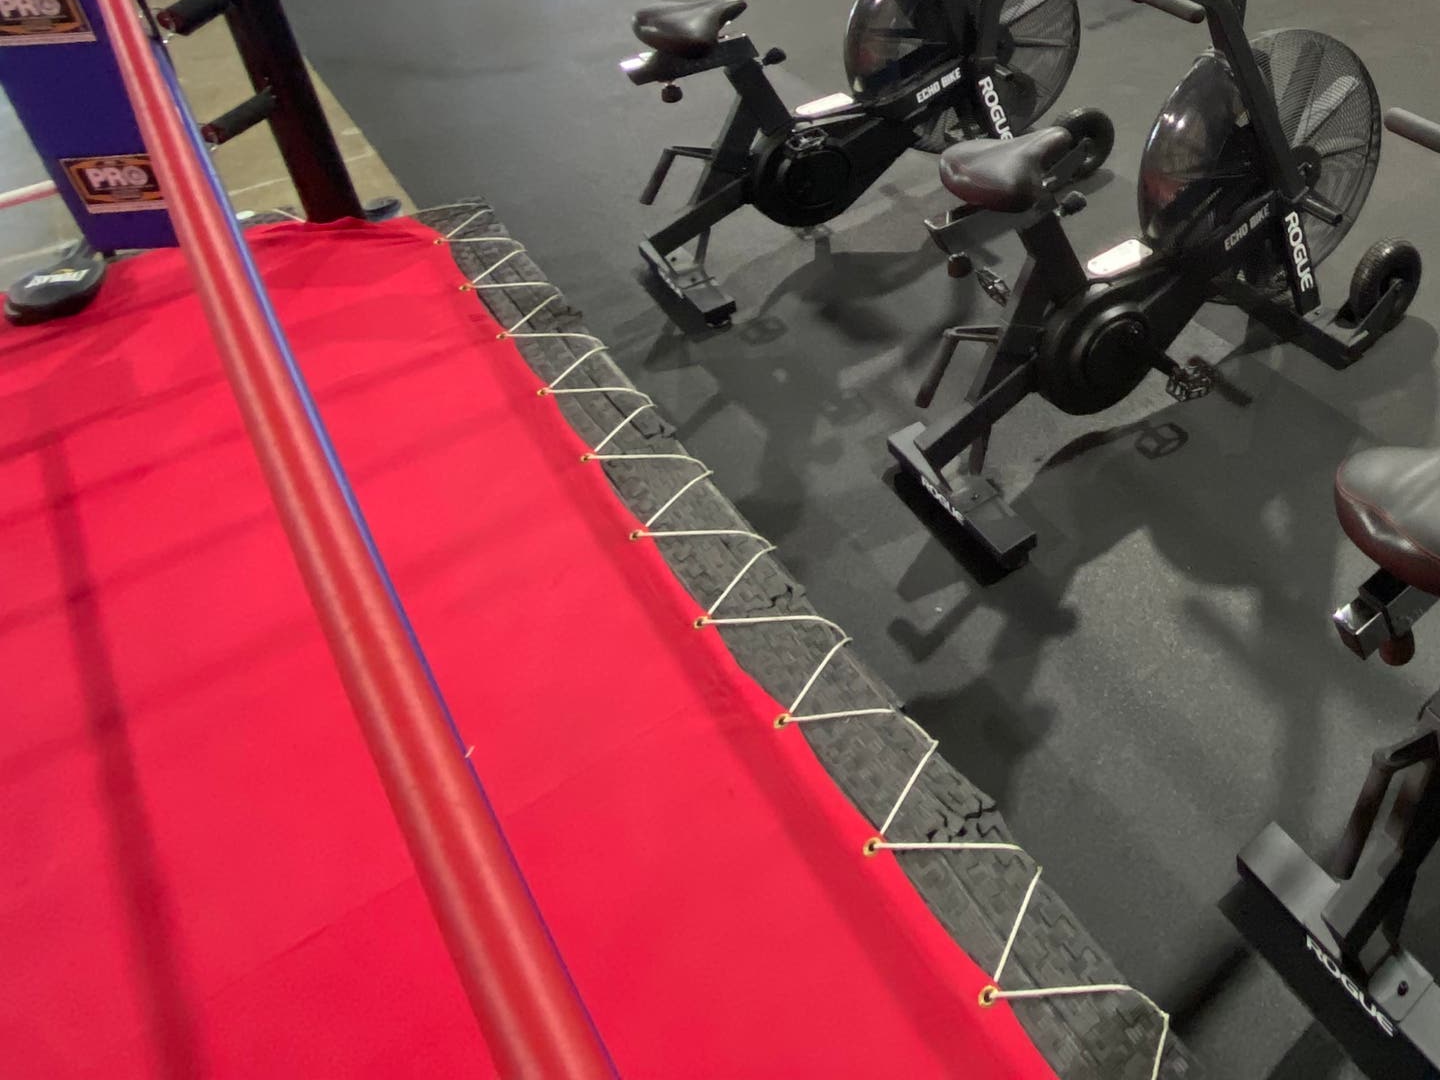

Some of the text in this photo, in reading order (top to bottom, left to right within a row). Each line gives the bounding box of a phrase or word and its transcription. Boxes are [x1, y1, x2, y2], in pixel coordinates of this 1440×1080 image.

[915, 67, 962, 104] ECHO BIKE
[978, 75, 1014, 141] ROGUE
[1223, 222, 1249, 251] ECHO
[1284, 211, 1314, 293] ROGUE
[1305, 934, 1395, 1038] ROGUE
